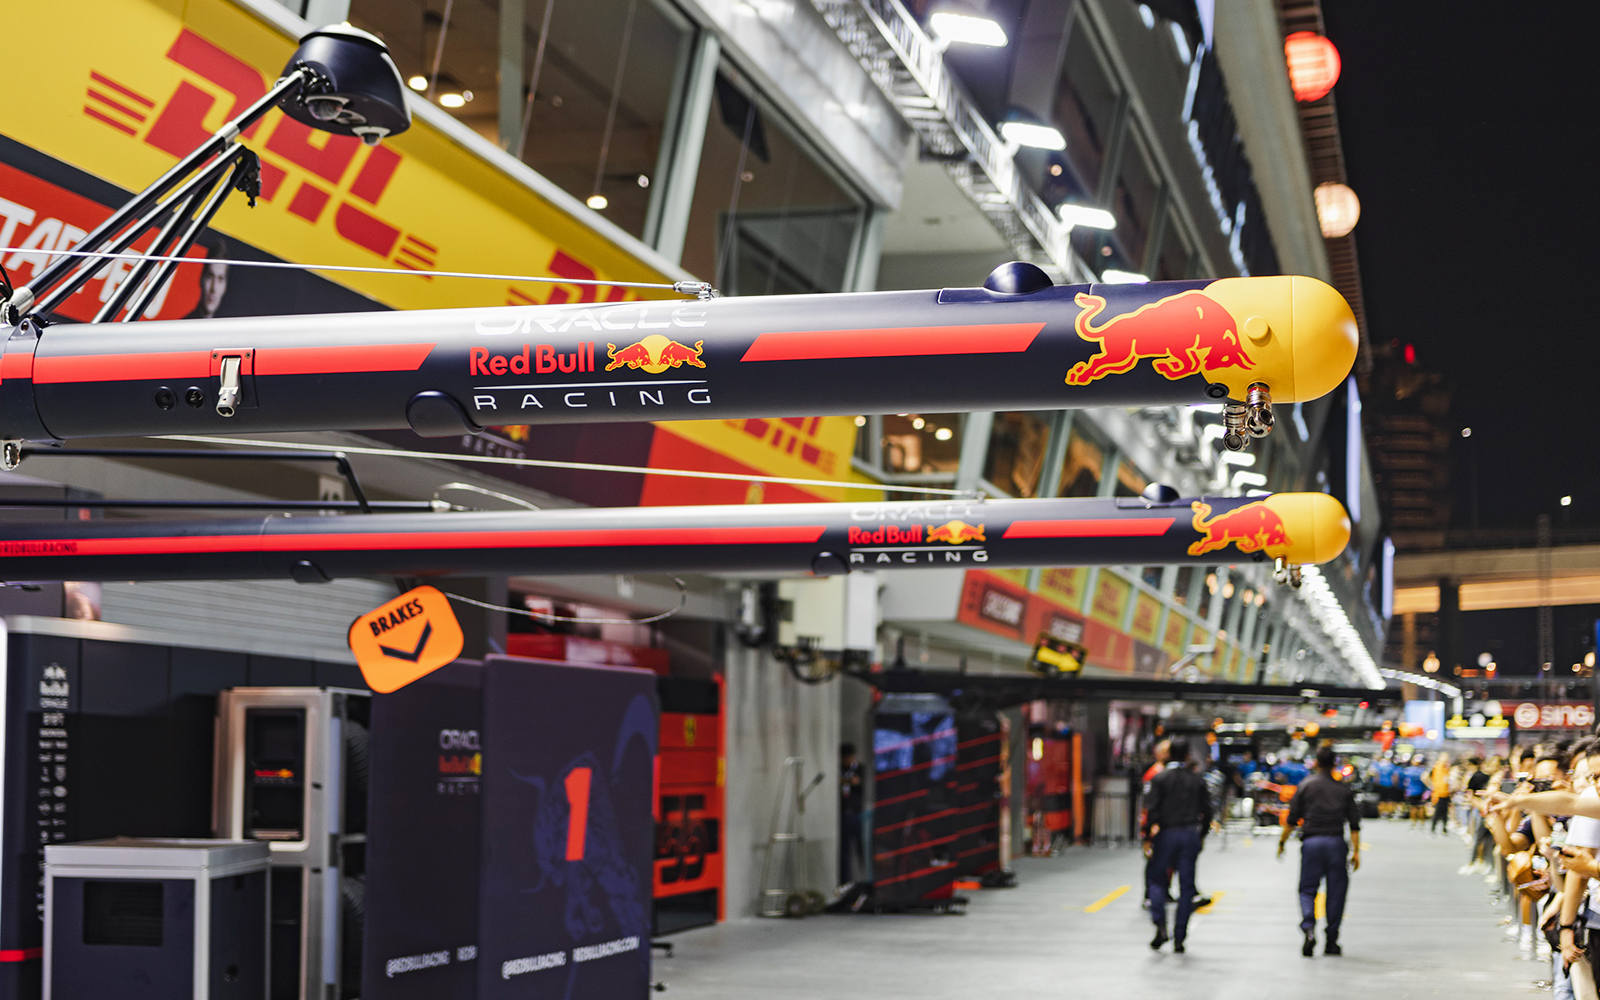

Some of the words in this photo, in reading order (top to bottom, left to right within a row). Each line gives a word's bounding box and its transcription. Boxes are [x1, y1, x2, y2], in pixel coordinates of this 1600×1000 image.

[474, 307, 708, 335] ORACLE
[473, 388, 711, 410] RACING
[850, 503, 985, 521] ORACLE
[849, 550, 989, 563] RACING
[369, 598, 424, 637] BRAKES
[564, 767, 592, 861] 1
